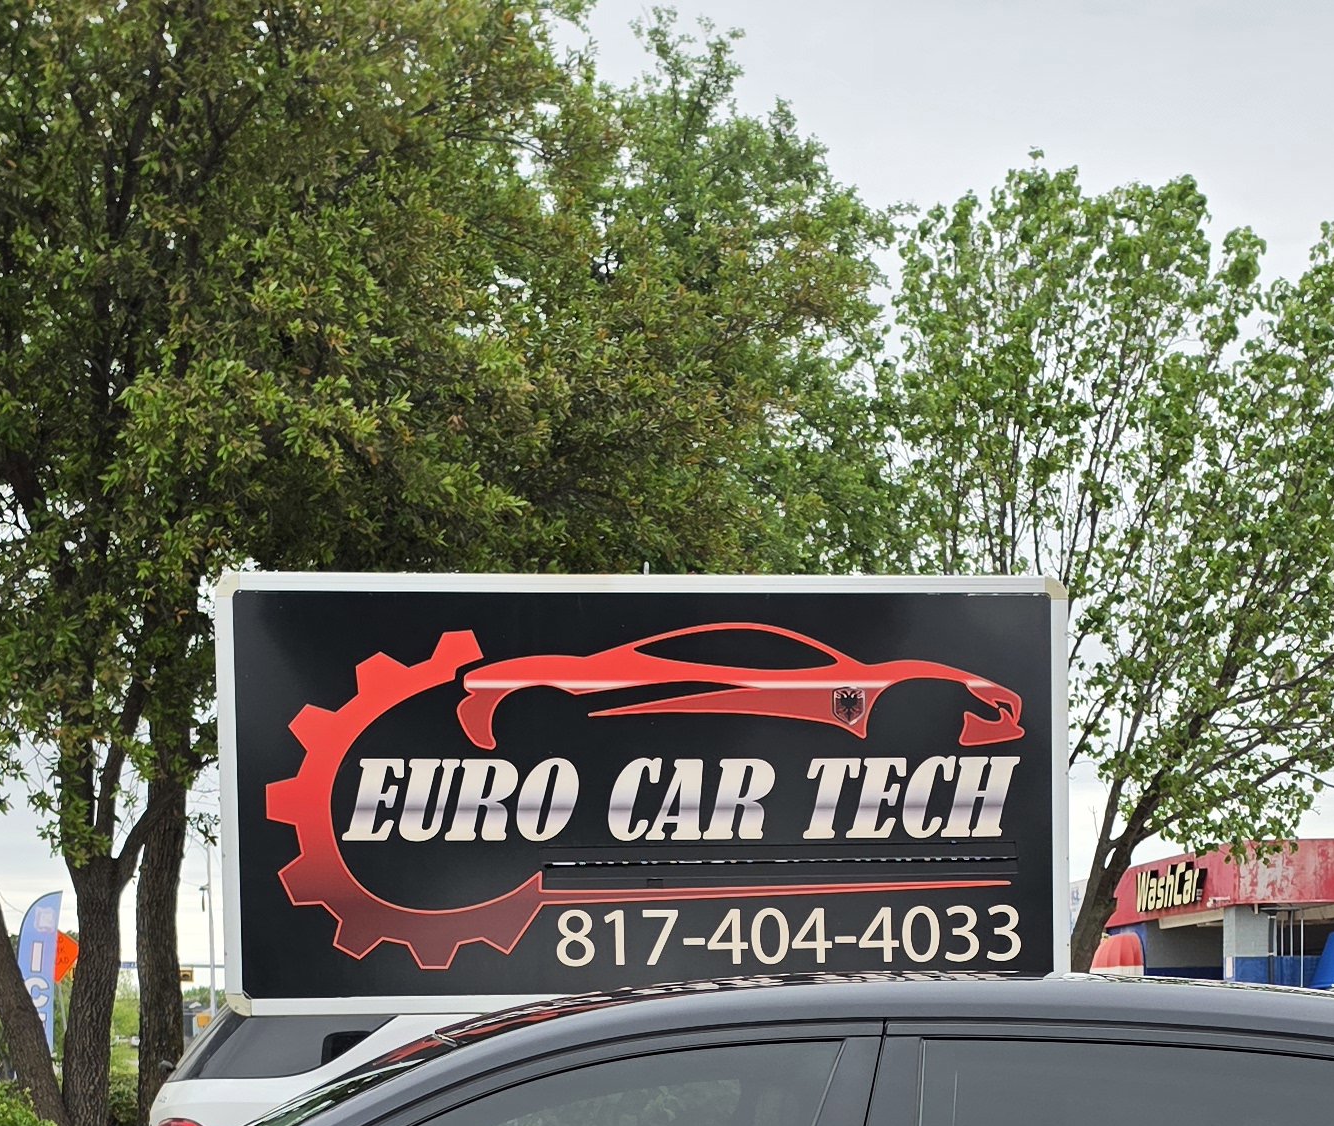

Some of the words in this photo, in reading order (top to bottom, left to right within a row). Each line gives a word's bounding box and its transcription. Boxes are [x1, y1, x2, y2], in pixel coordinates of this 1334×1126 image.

[341, 756, 580, 843] EURO
[606, 756, 777, 842] CAR
[802, 755, 1021, 841] TECH
[1136, 861, 1200, 913] WashCar
[555, 904, 1024, 968] 817-404-4033
